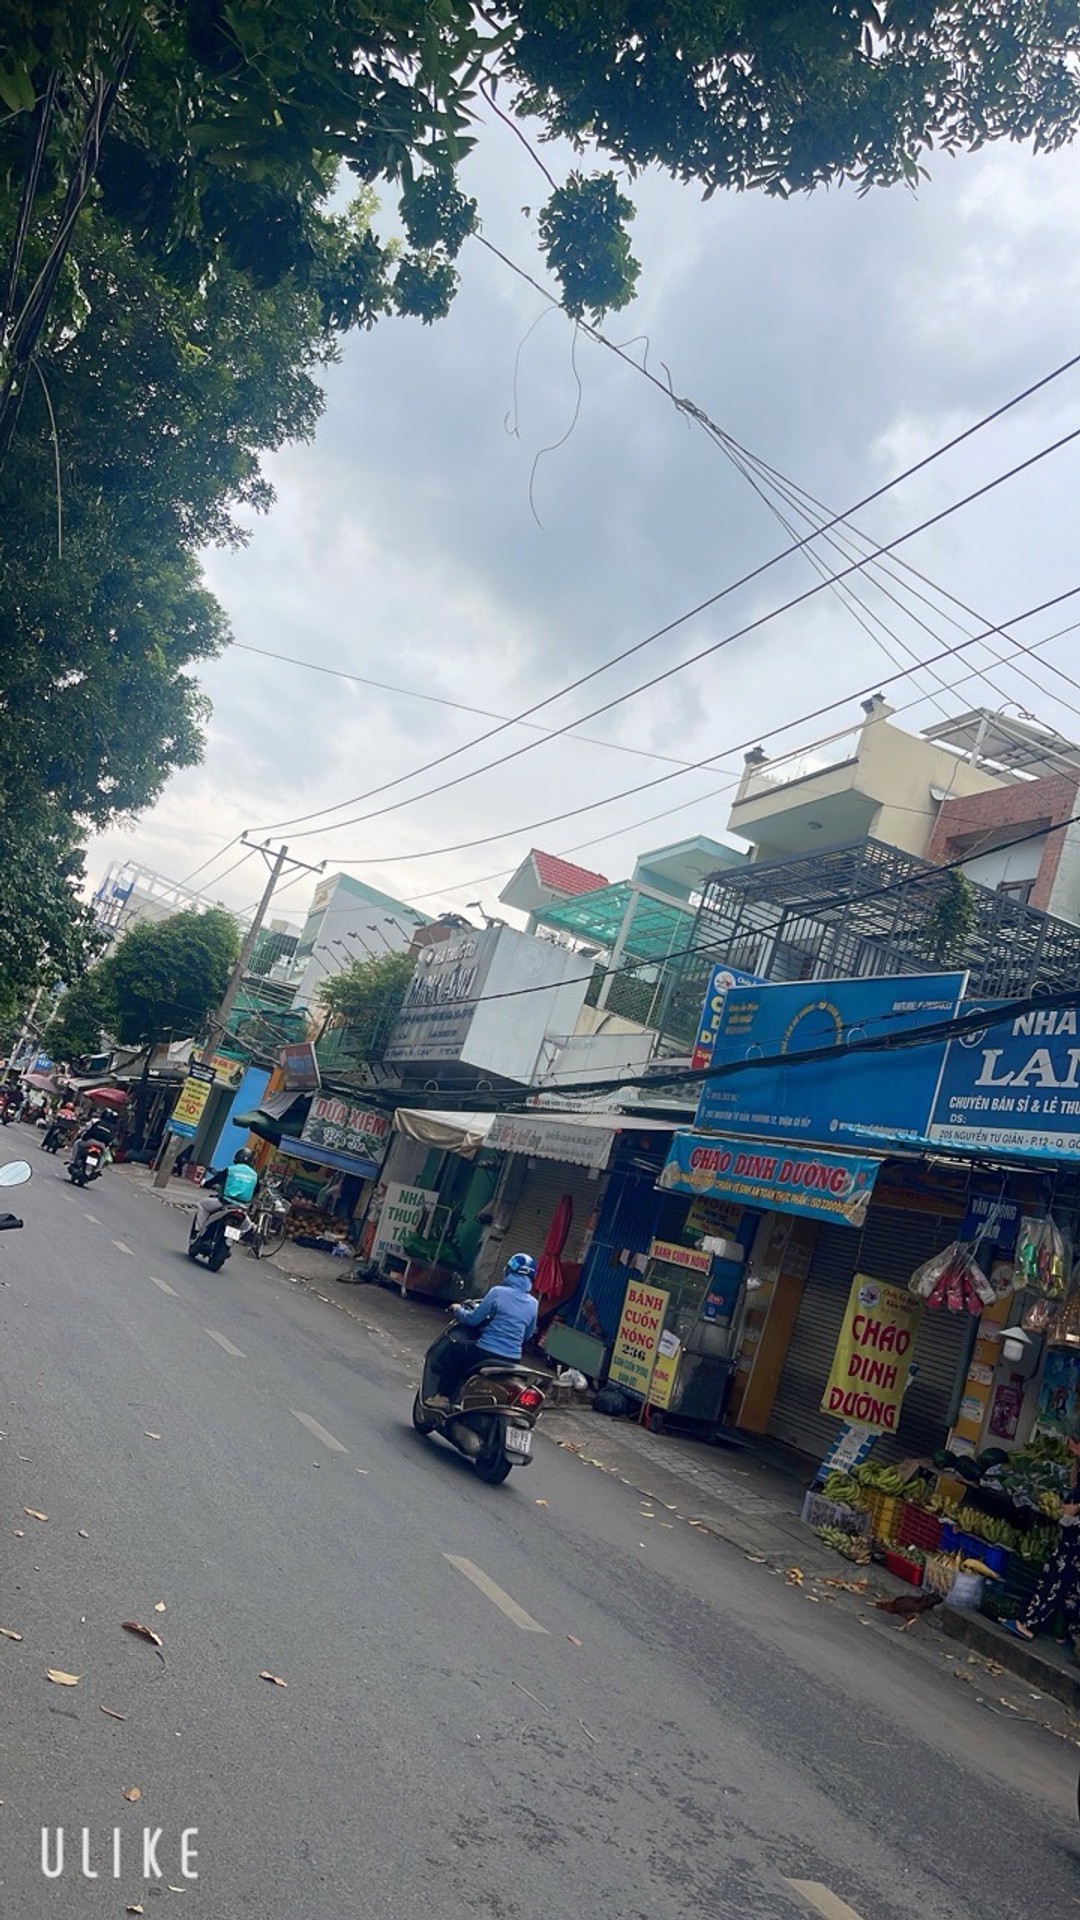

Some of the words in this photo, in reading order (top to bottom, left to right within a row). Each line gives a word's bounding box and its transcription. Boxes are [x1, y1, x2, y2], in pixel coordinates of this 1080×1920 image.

[949, 1095, 990, 1110] CHUYÊN
[991, 1096, 1015, 1112] BÁN
[1031, 1100, 1041, 1113] &
[349, 1108, 387, 1137] XIÊM
[949, 1113, 967, 1123] DS:
[954, 1130, 988, 1142] NGUYỄN
[689, 1145, 732, 1174] CHÁO
[733, 1153, 778, 1181] DINH
[628, 1288, 664, 1311] BÁNH
[624, 1309, 659, 1331] CUỐN
[620, 1326, 655, 1350] NÓNG
[851, 1314, 911, 1356] CHÁO
[621, 1343, 647, 1362] 236
[847, 1353, 898, 1390] DINH
[828, 1385, 898, 1429] DƯỠNG
